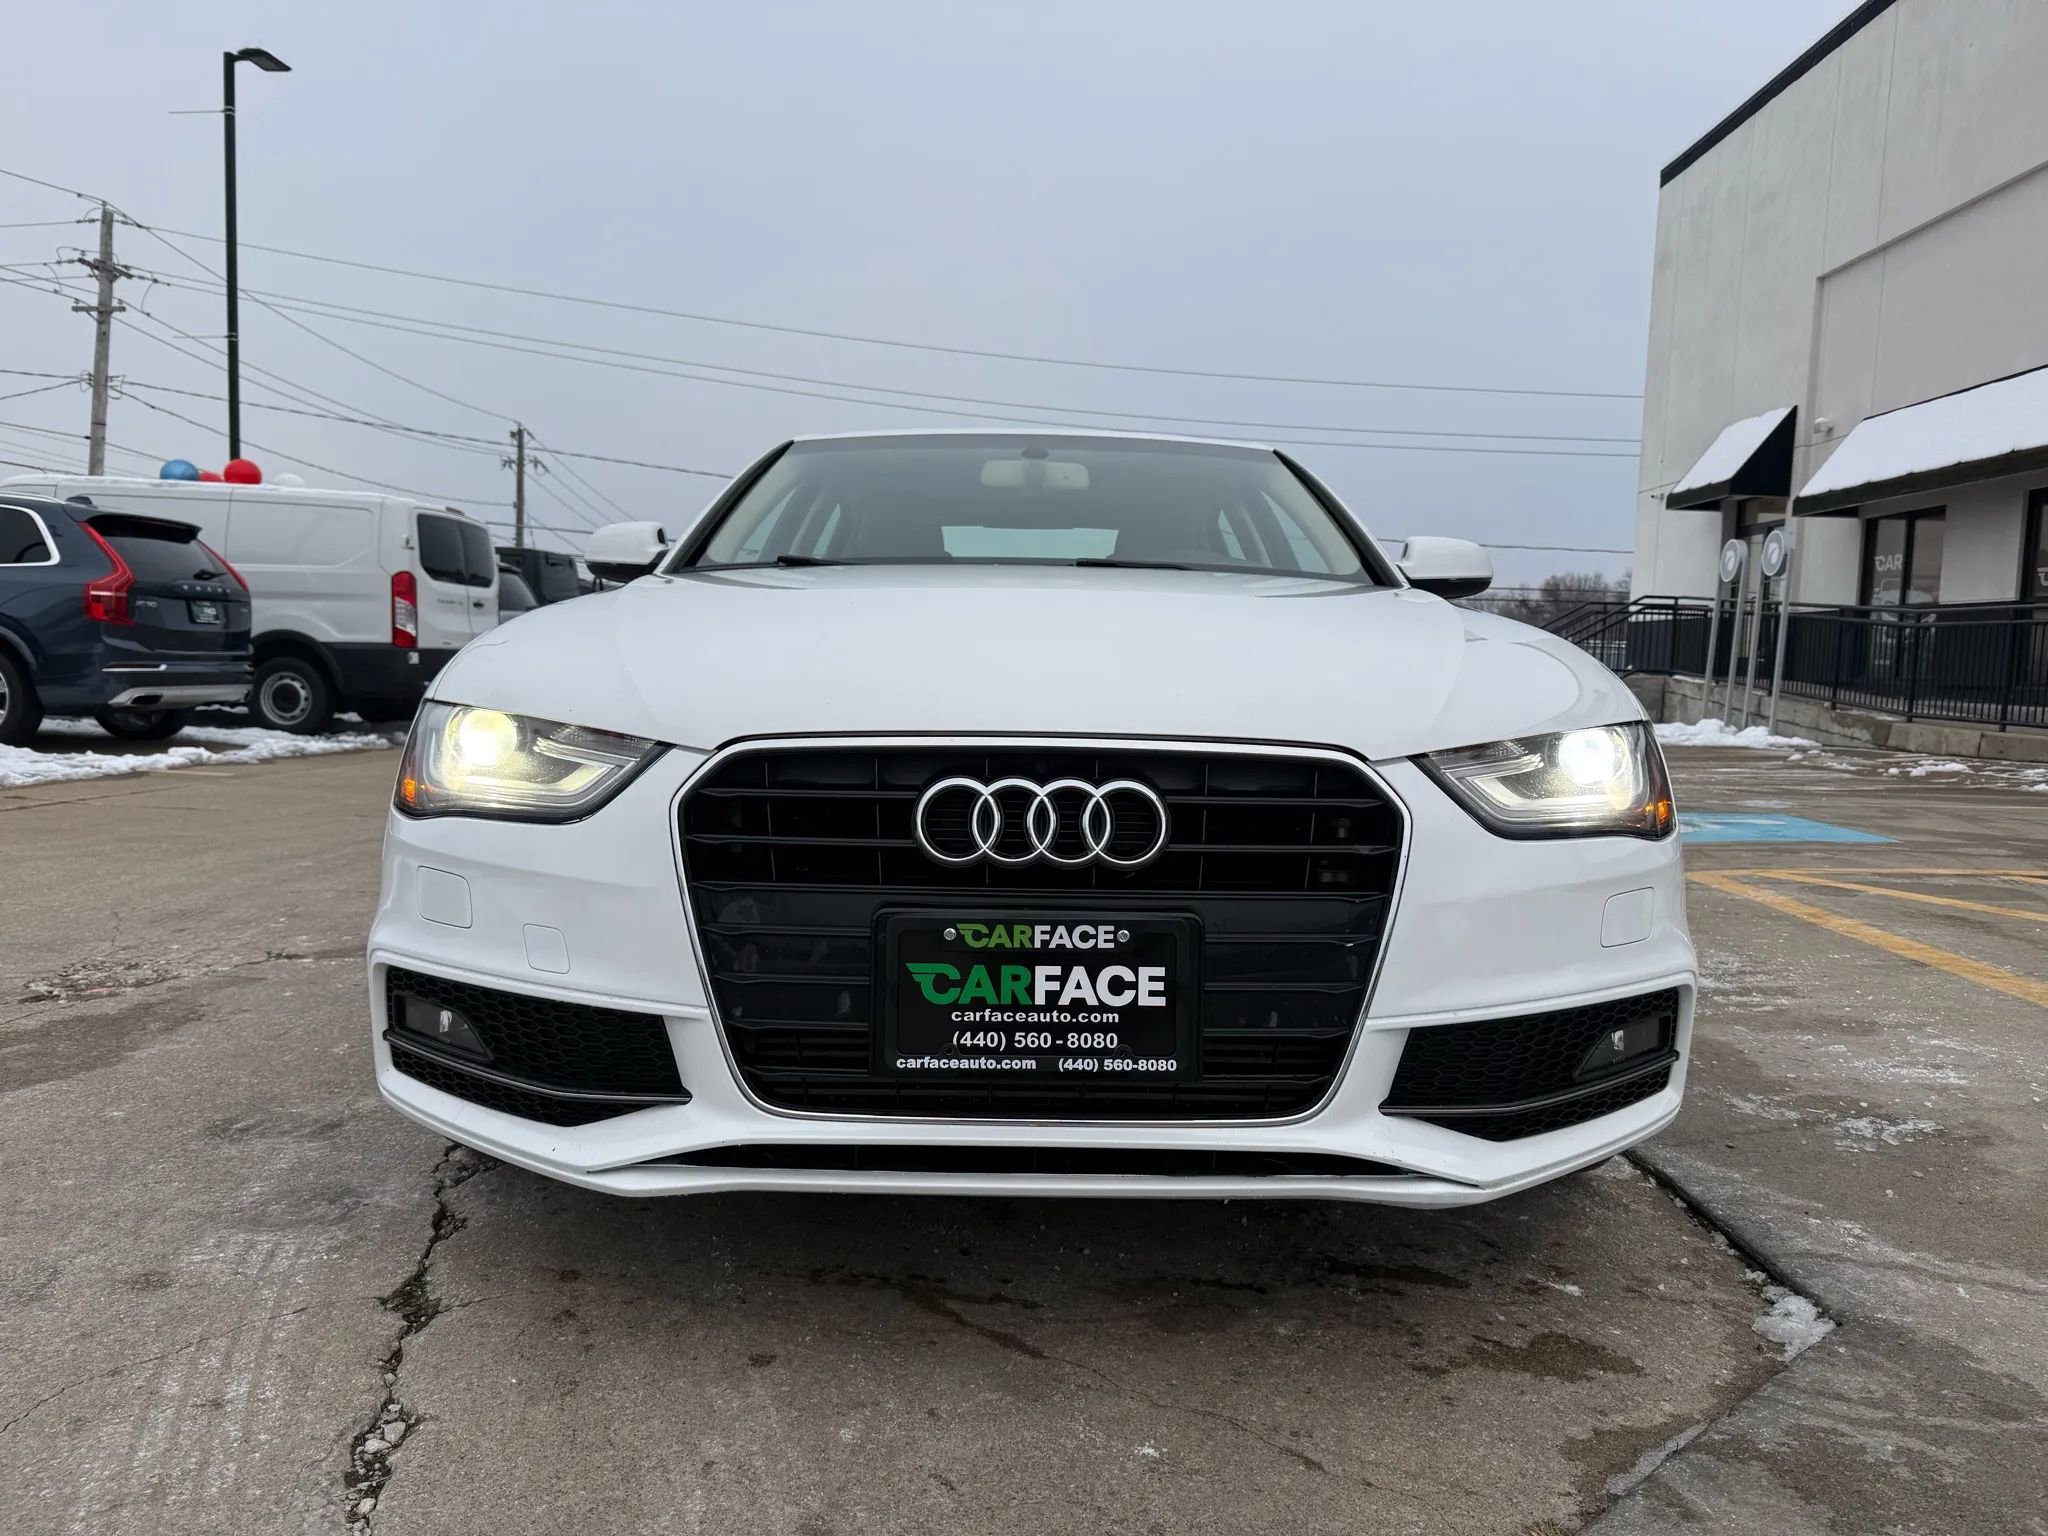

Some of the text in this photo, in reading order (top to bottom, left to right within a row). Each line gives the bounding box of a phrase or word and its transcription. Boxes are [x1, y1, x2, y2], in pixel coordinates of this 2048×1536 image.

[1874, 554, 1903, 571] CAR
[956, 923, 1115, 949] CARFACE
[905, 962, 1166, 1007] CARFACE
[951, 1009, 1119, 1023] carfaceauto.com
[952, 1031, 1006, 1051] (440)
[896, 1056, 1037, 1070] carfaceauto.com
[1058, 1058, 1177, 1072] (440) 560-8080
